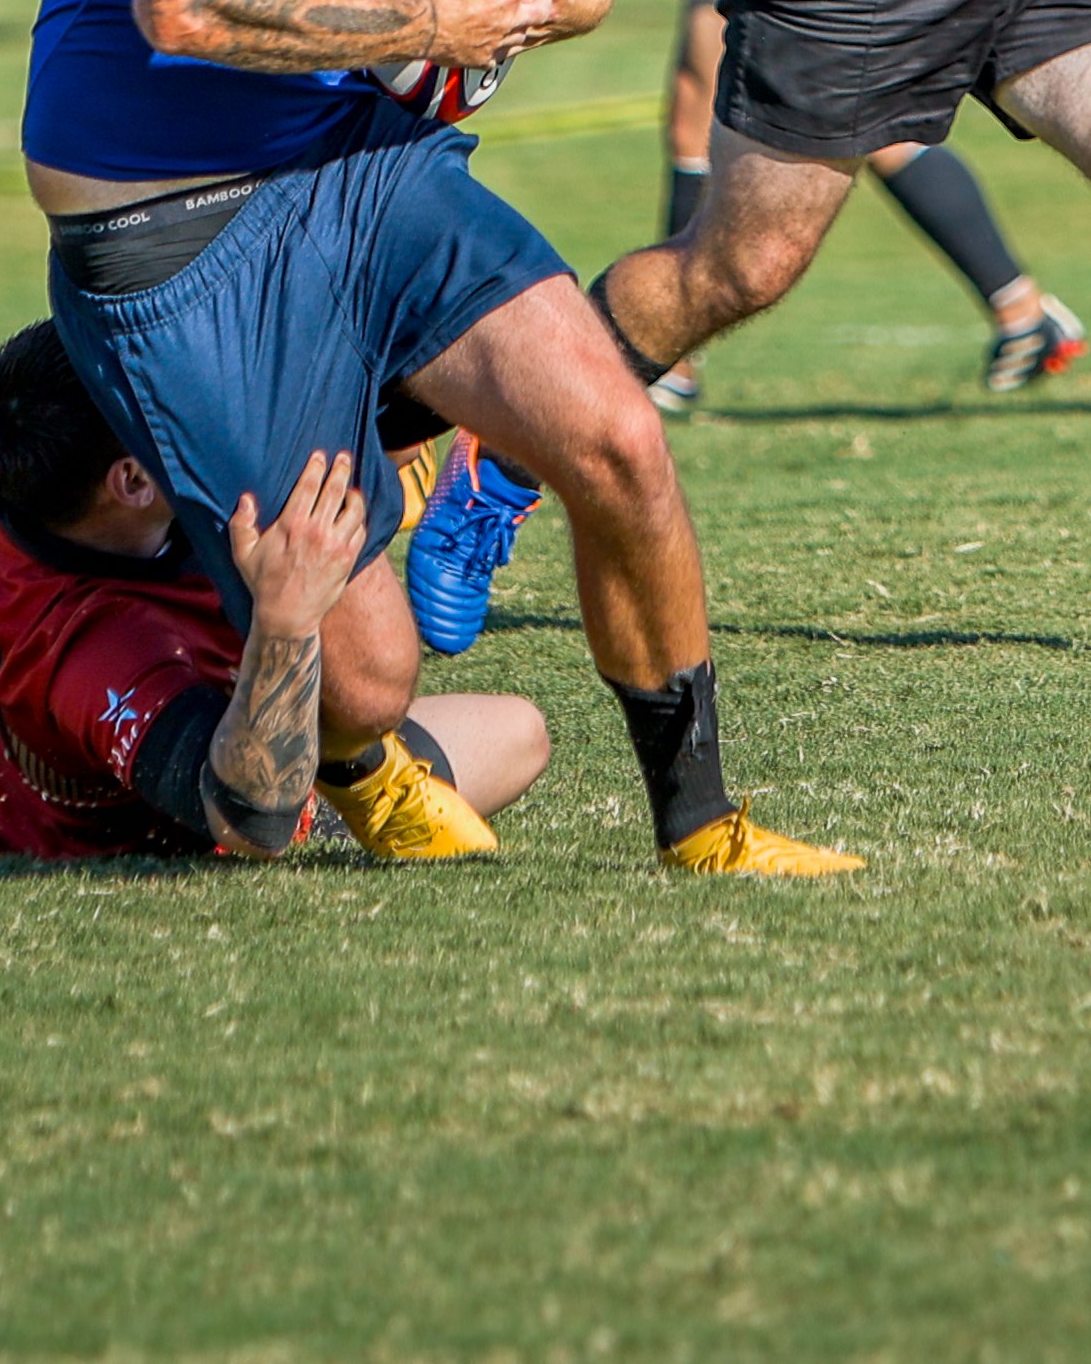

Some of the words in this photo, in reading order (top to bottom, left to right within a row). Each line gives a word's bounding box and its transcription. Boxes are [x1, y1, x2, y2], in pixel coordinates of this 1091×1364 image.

[59, 222, 105, 237] AMBOO
[108, 211, 151, 231] COOL
[185, 185, 253, 211] BAMBOO
